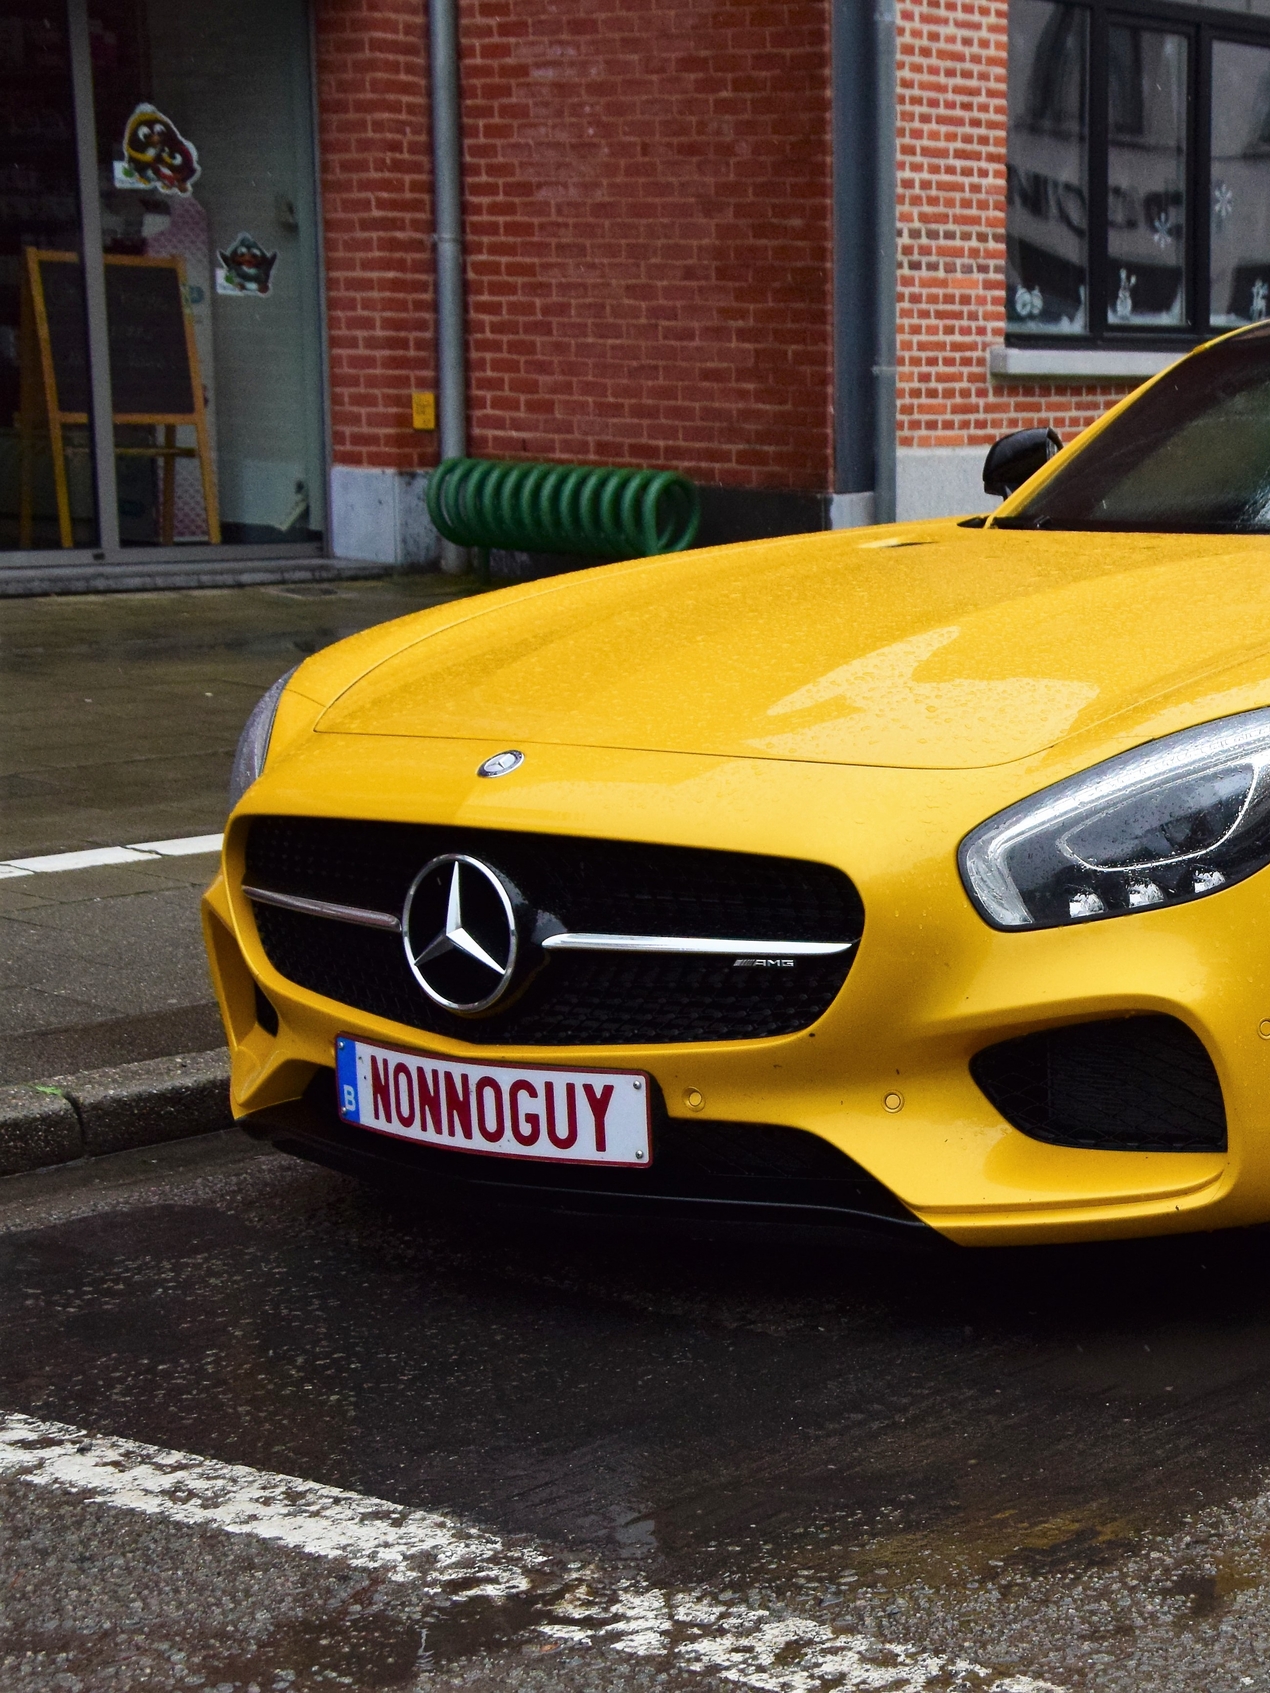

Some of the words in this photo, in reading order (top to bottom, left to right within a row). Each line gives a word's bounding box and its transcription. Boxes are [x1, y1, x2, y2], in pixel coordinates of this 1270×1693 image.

[752, 959, 795, 967] AMG
[343, 1084, 356, 1112] B
[370, 1054, 615, 1153] NONNOGUY
